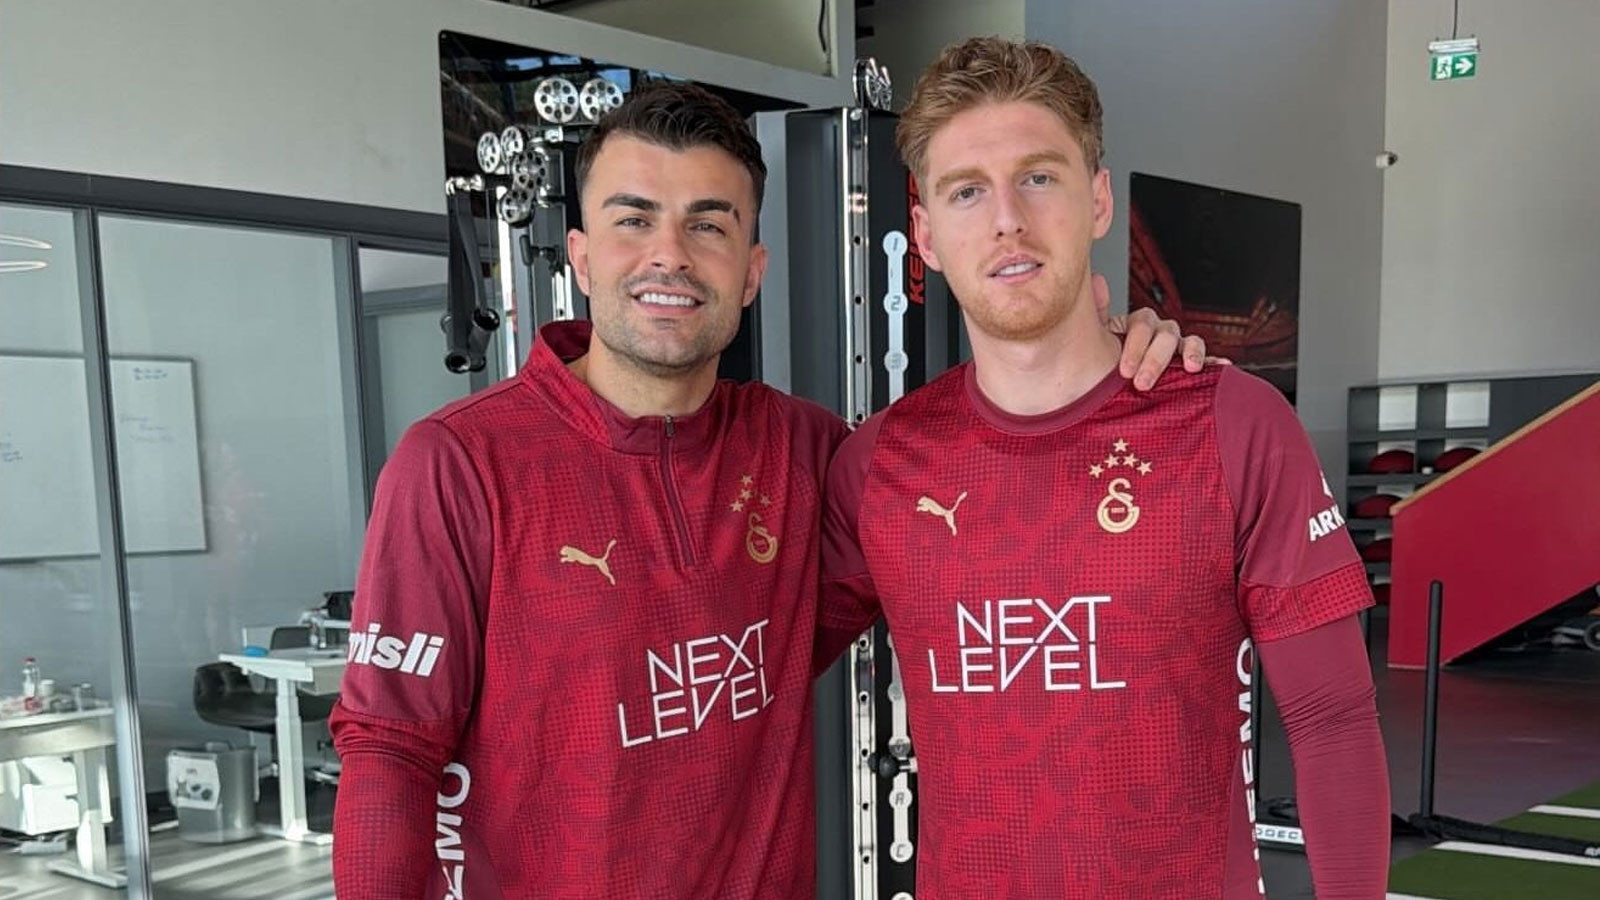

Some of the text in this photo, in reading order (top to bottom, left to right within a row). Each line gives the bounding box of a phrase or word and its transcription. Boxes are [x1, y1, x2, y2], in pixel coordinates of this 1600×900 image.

[891, 295, 901, 311] 2
[956, 595, 1112, 646] NEXT
[647, 618, 769, 694] NEXT
[928, 643, 1126, 692] LEVEL
[618, 667, 774, 747] LEVEL
